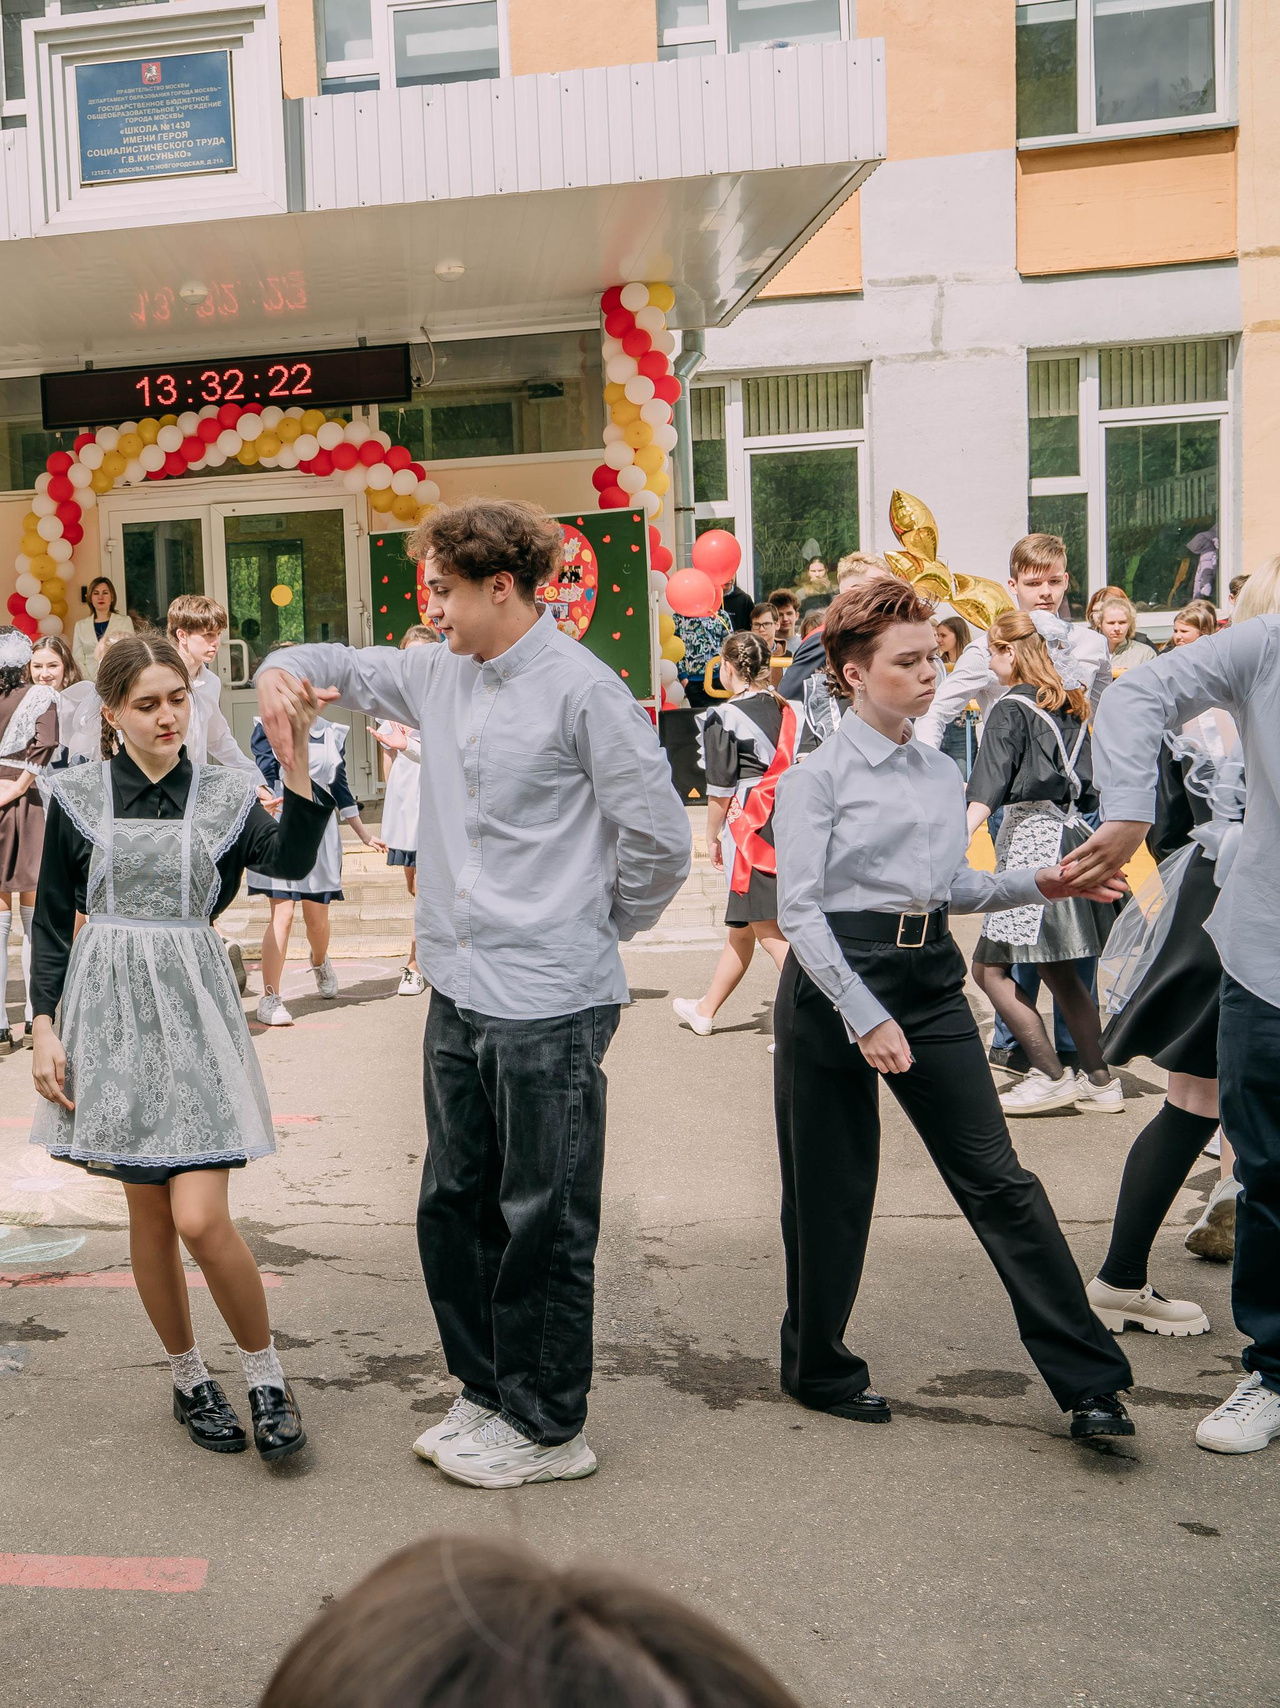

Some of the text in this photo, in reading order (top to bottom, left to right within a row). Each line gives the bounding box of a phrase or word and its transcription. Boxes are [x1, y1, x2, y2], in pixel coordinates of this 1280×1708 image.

[88, 96, 128, 105] ДЕПАРТАМЕНТ
[129, 92, 170, 101] ОБРАЗОВАНИЯ
[171, 89, 193, 97] ГОРОДА
[116, 85, 164, 94] ПРАВИТЕЛЬСТВО
[87, 101, 222, 120] ОБЩЕОБРАЗОВАТЕЛЬНОЕ УЧРЕЖДЕНИЕ
[98, 95, 210, 112] ГОСУДАРСТВЕННОЕ БЮДЖЕТНОЕ
[125, 112, 184, 124] ГОРОДА МОСКВЫ
[120, 120, 191, 135] «ШКОЛА №1430
[123, 130, 189, 145] ИМЕНИ ГЕРОЯ
[87, 136, 226, 157] СОЦИАЛИСТИЧЕСКОГО ТРУДА
[121, 150, 192, 164] Г.В.КИСУНЬКО»
[135, 363, 312, 407] 13:32:22
